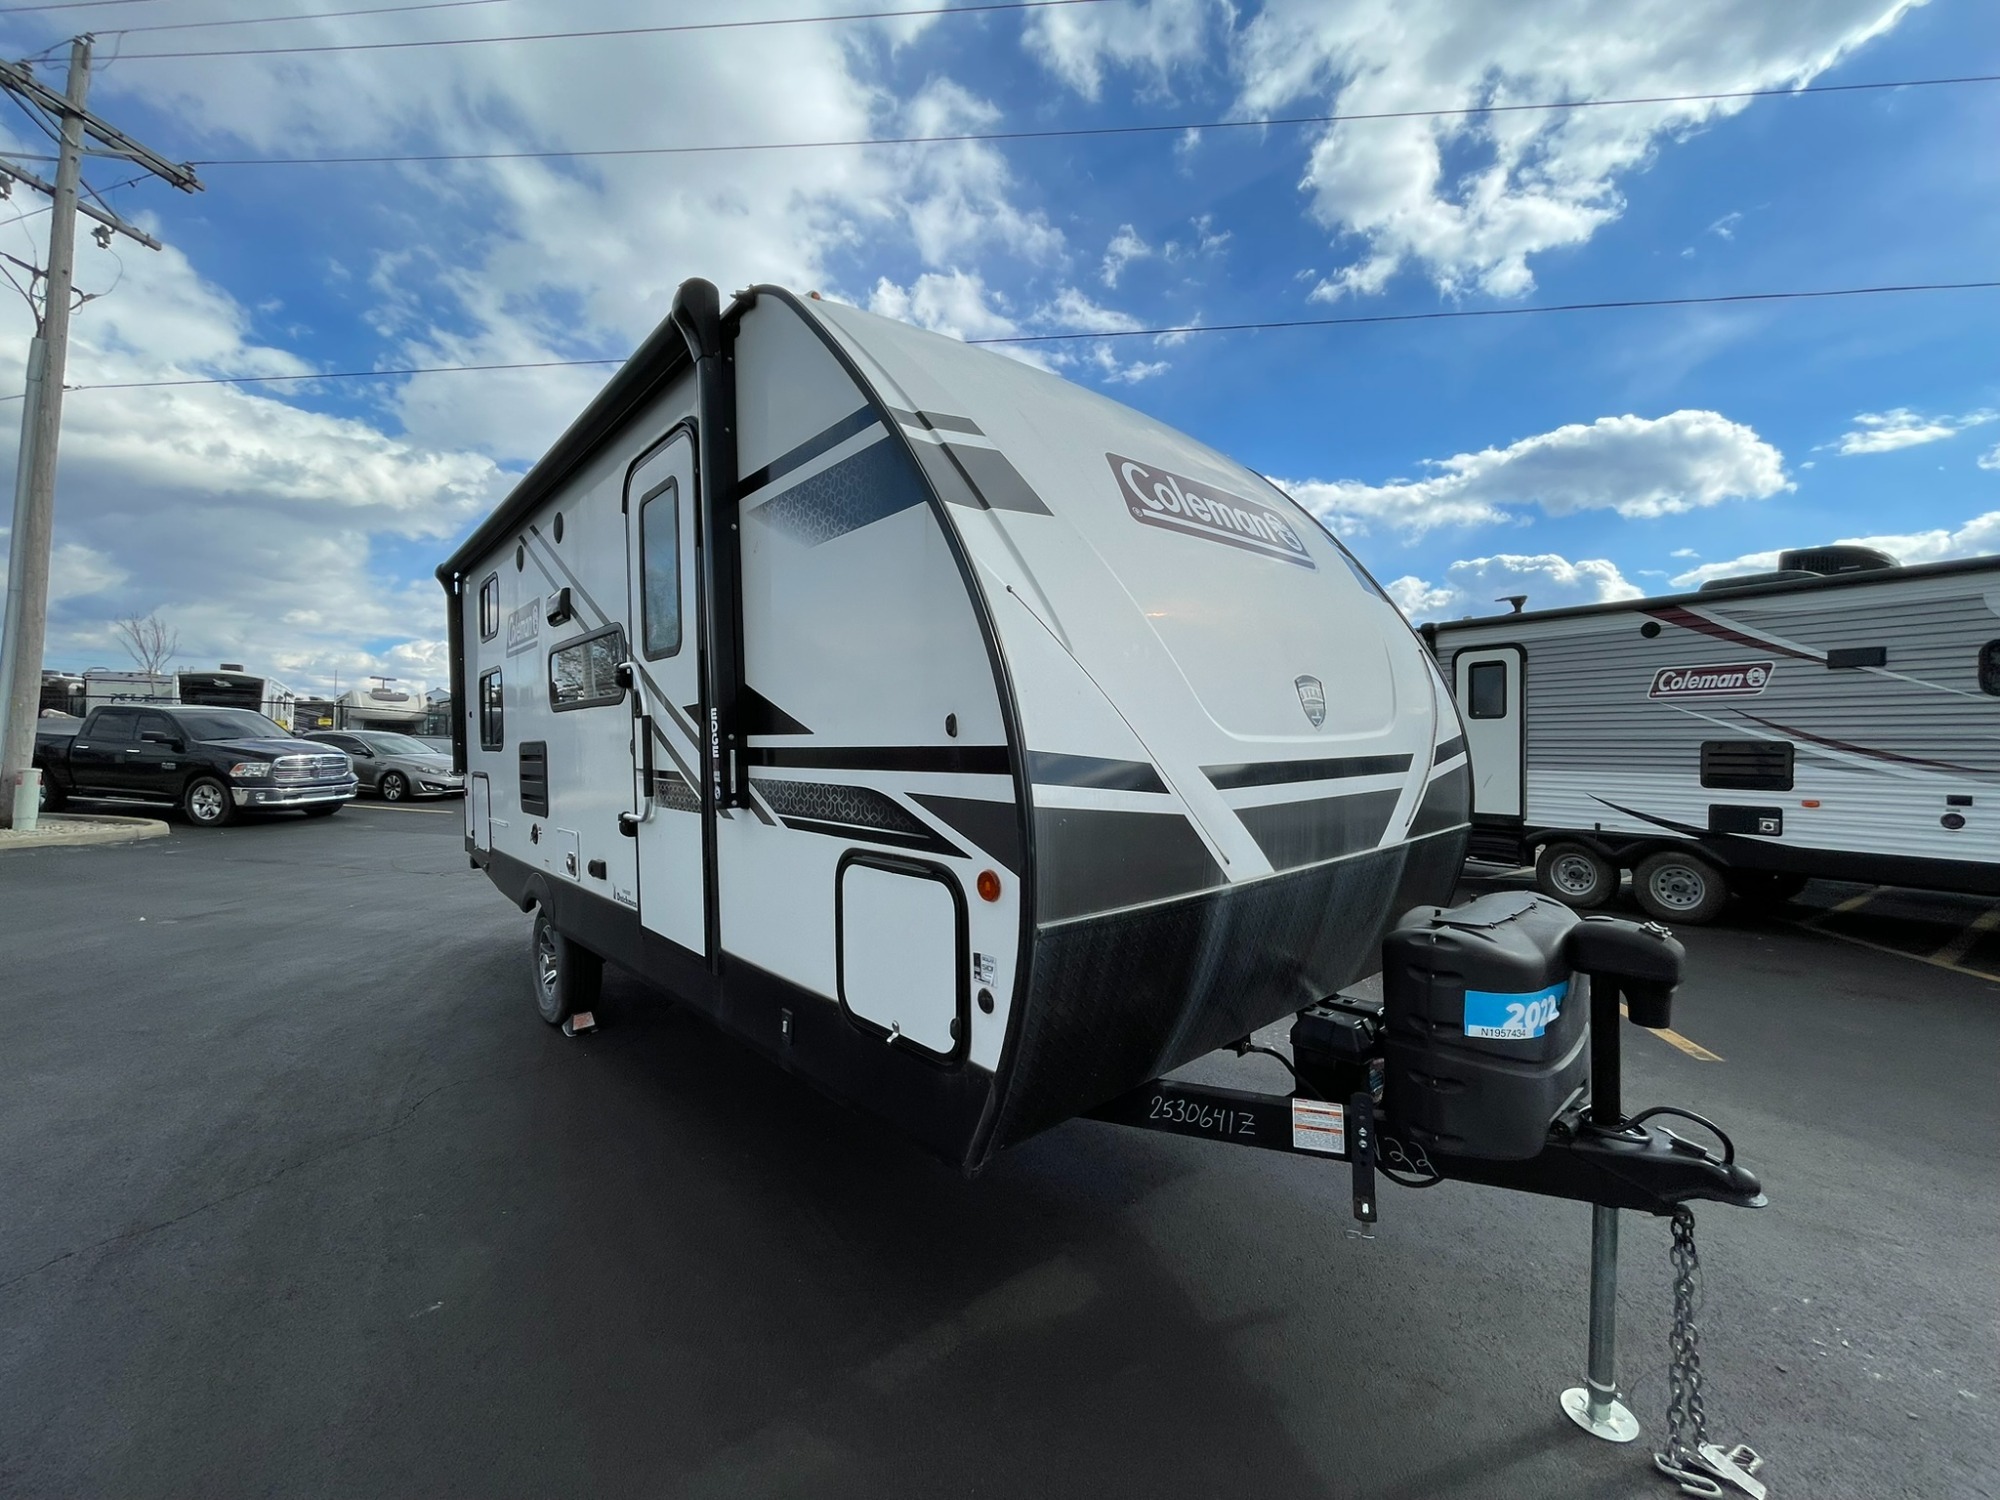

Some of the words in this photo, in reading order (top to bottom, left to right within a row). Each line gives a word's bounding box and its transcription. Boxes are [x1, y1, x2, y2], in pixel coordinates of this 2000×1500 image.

[1121, 461, 1278, 543] Coleman
[508, 612, 533, 647] Coleman
[1658, 670, 1744, 691] Coleman
[710, 707, 720, 758] EDGE
[1503, 994, 1560, 1032] 2022
[1480, 1027, 1526, 1038] N1957434
[1149, 1095, 1256, 1135] 2530641Z
